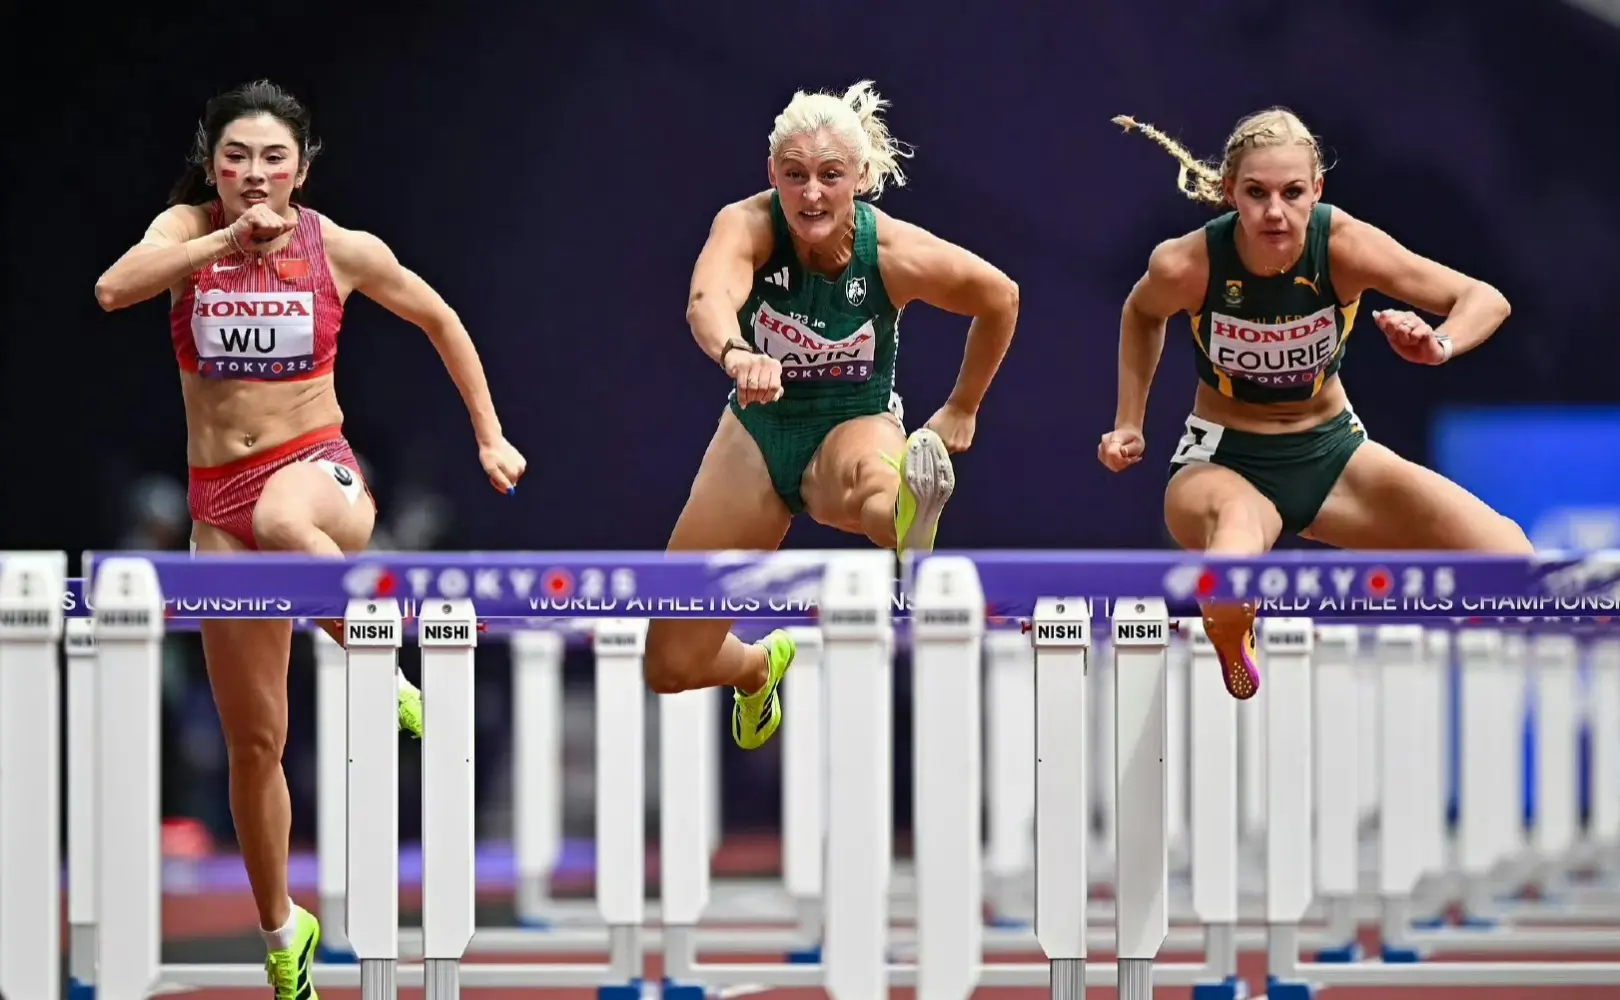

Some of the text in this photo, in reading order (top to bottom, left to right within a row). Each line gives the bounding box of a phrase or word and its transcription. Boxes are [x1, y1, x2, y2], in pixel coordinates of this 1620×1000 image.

[1213, 315, 1333, 344] HONDA
[219, 327, 276, 354] WU
[763, 337, 861, 365] LAVIN
[1217, 335, 1331, 371] FOURIE
[1180, 426, 1208, 456] 7
[528, 596, 618, 612] WORLD
[625, 596, 760, 612] ATHLETICS
[1318, 596, 1454, 612] ATHLETICS
[349, 624, 394, 641] NISHI
[424, 624, 469, 640] NISHI
[1037, 623, 1083, 640] NISHI
[1117, 623, 1163, 639] NISHI
